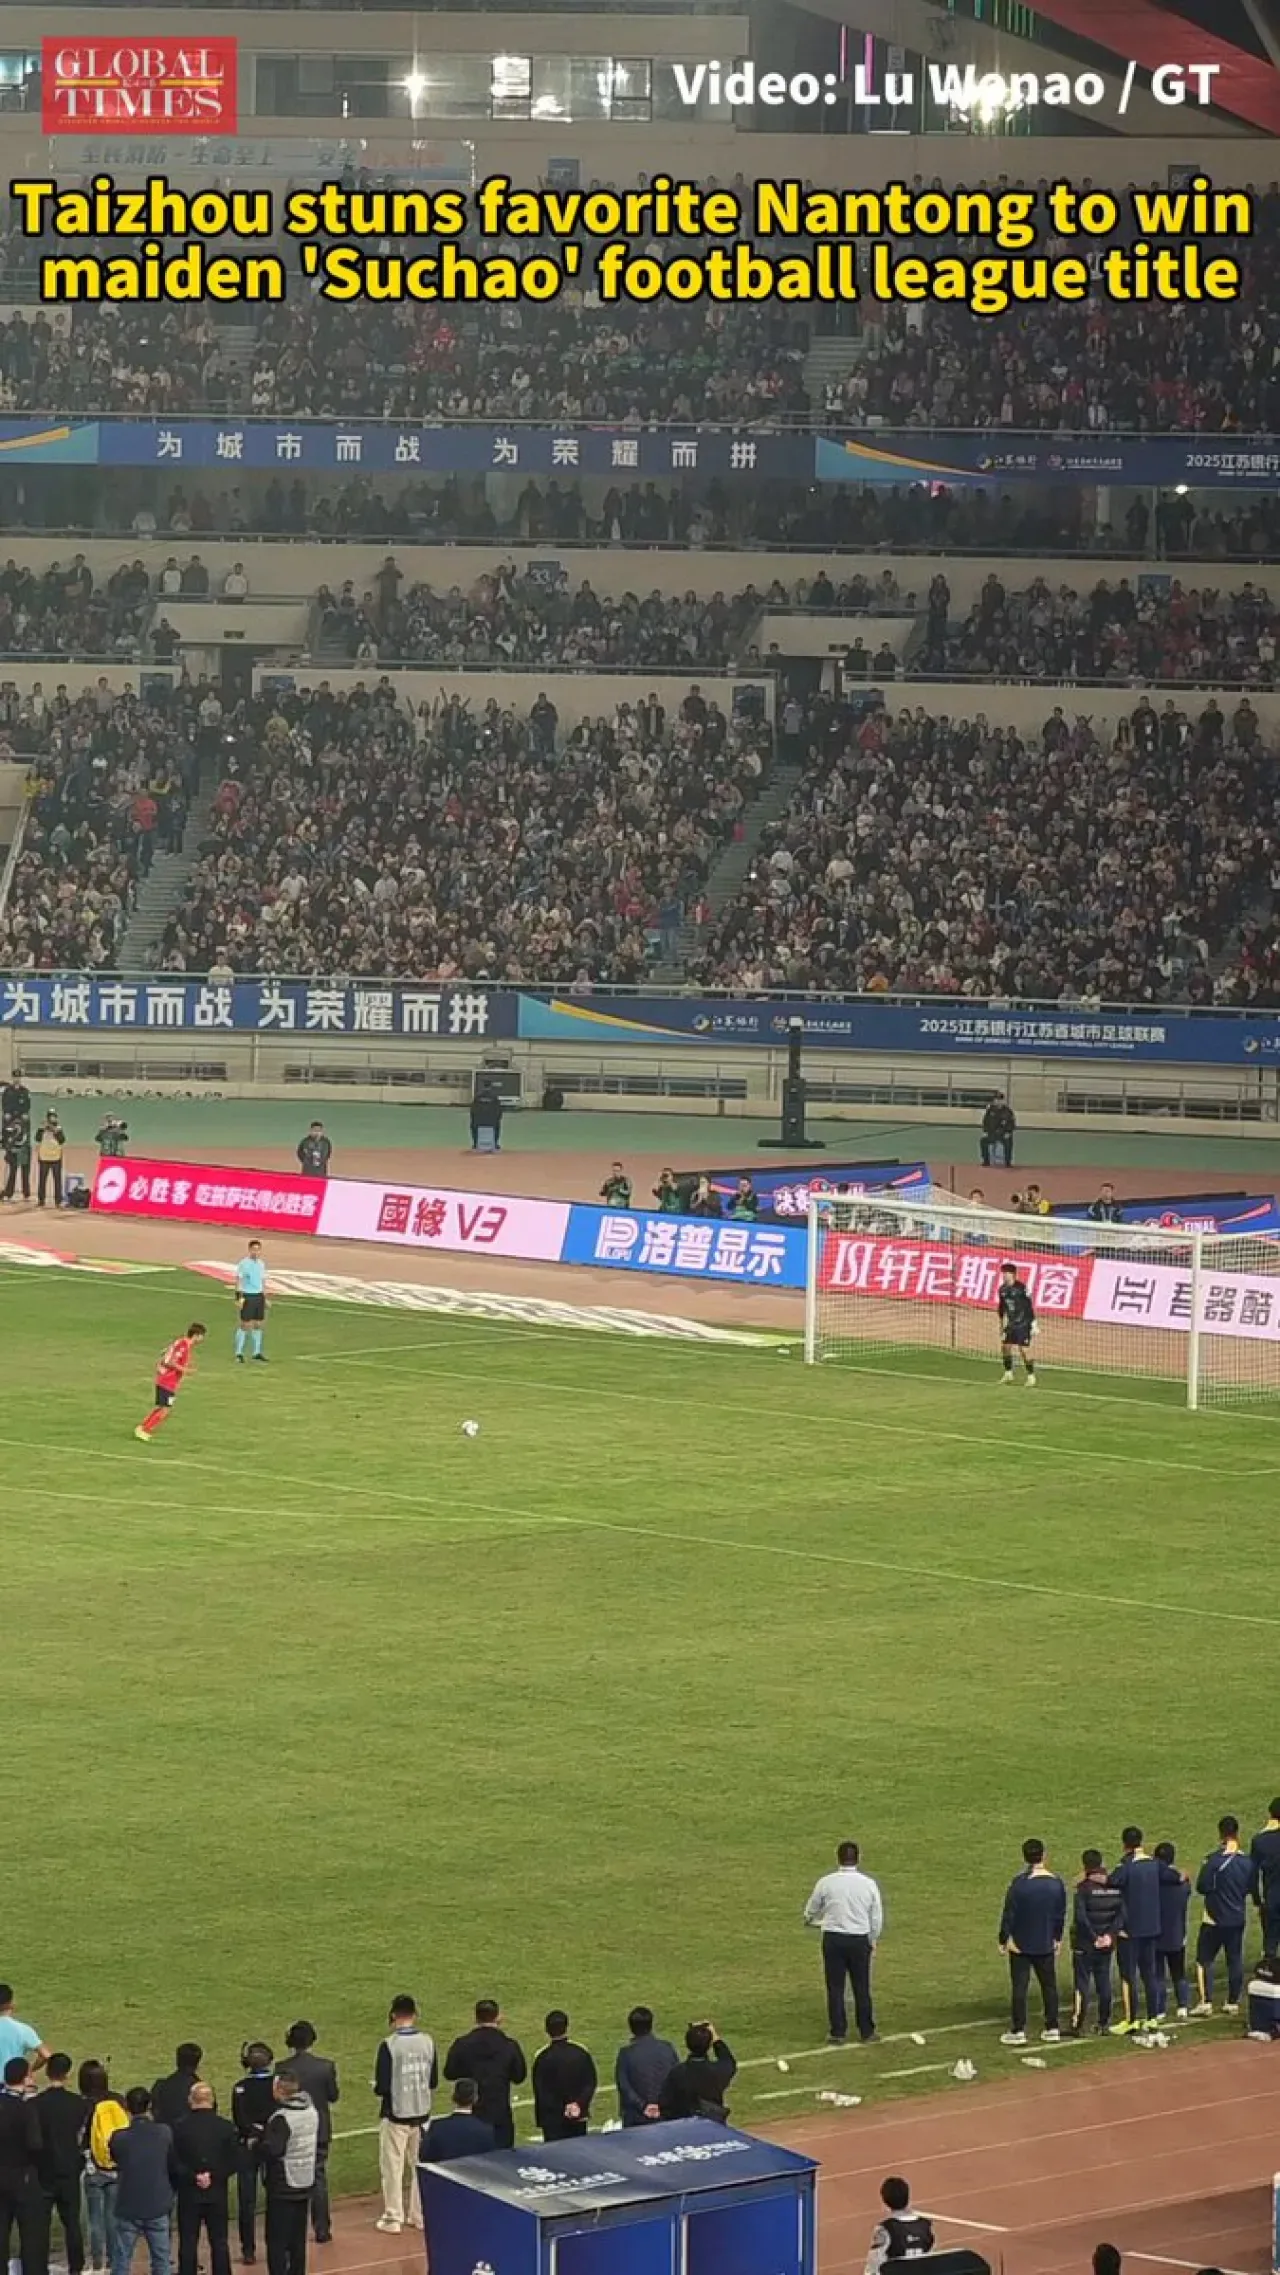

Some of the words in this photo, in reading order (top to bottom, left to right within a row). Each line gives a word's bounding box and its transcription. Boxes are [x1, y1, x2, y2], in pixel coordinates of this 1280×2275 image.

[157, 431, 421, 464] 为城市而战
[493, 438, 757, 469] 为荣耀而拼
[3, 982, 234, 1027] 为城市而战
[258, 988, 489, 1034] 为荣耀而拼
[456, 1203, 508, 1244] V3
[638, 1219, 787, 1278] 洛普显示
